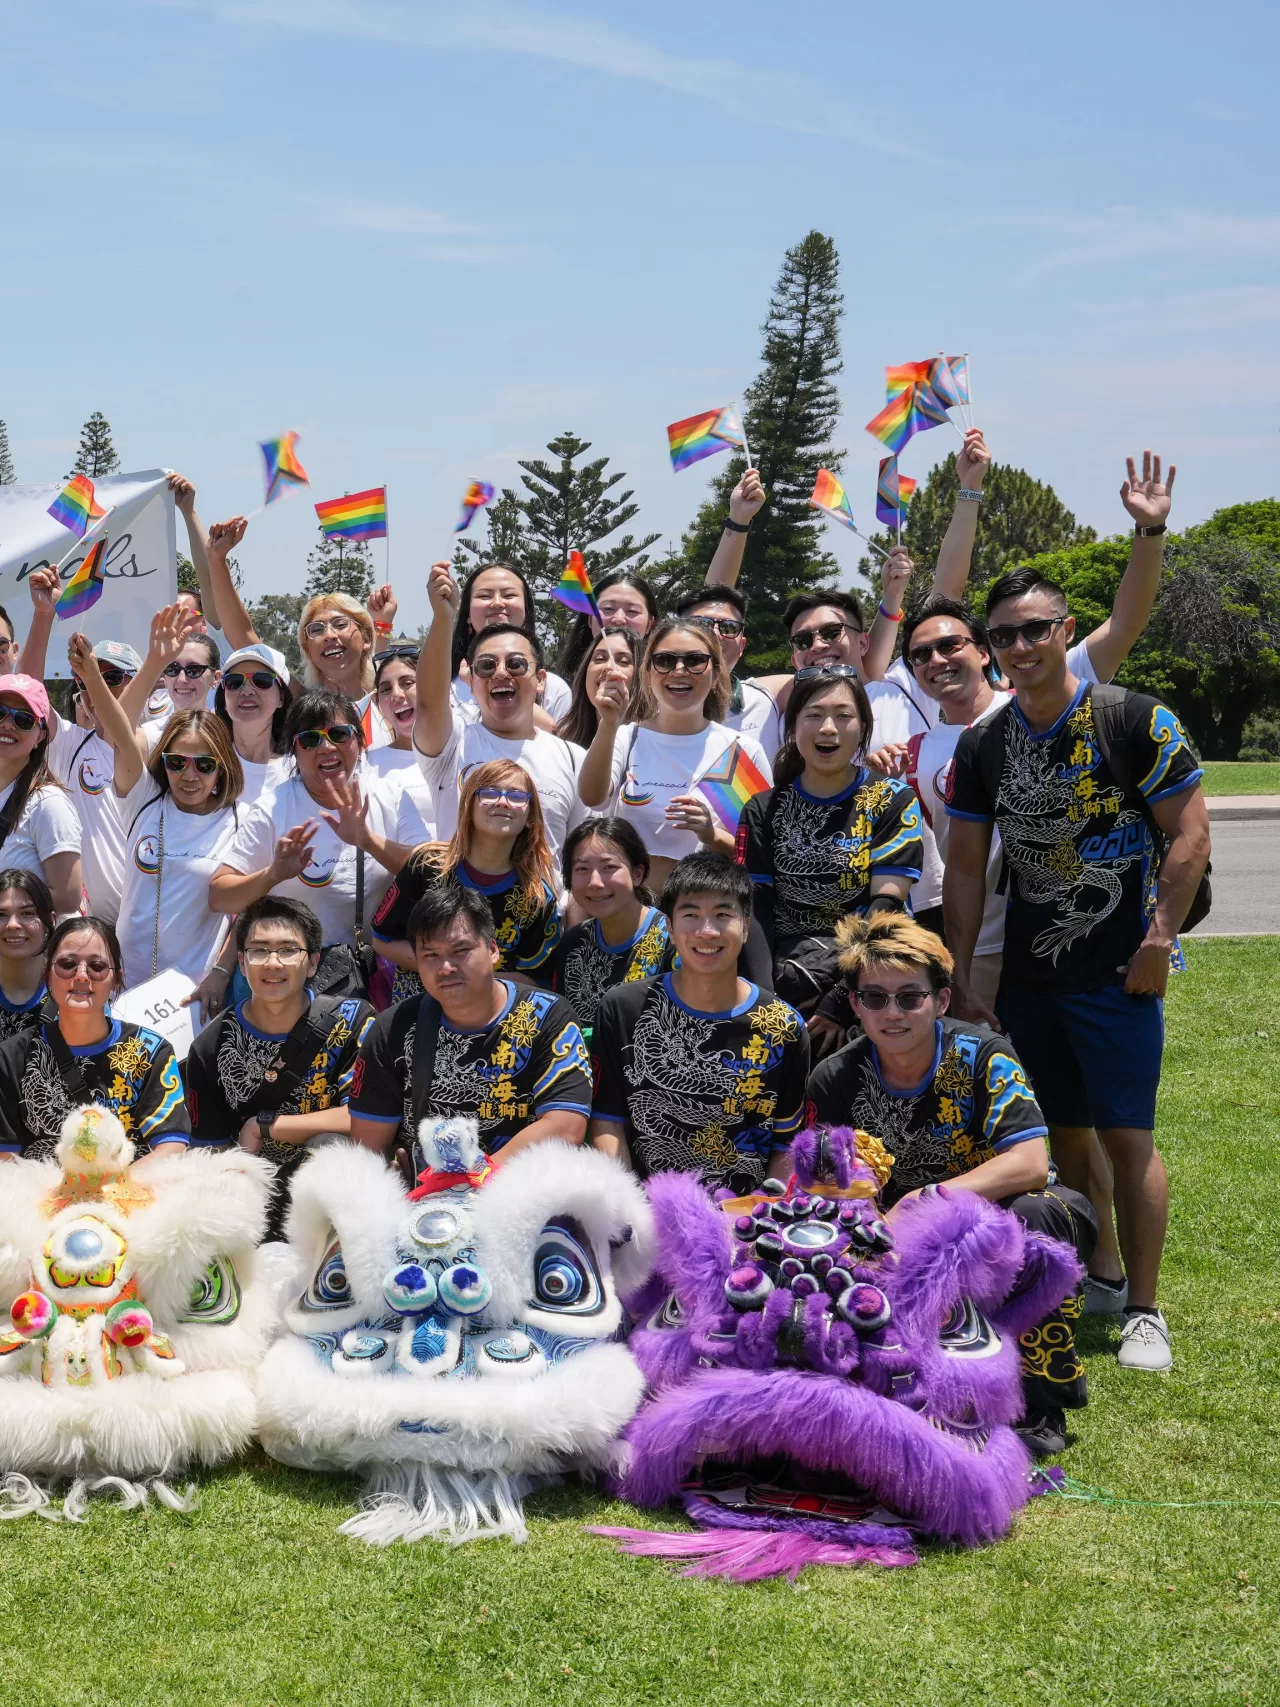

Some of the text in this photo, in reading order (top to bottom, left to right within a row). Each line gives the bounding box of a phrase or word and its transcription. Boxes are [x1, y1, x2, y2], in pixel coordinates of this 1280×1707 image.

[16, 533, 158, 584] nals
[642, 781, 689, 789] peacock
[1069, 739, 1099, 801] 南海
[848, 813, 873, 871] 南海
[144, 998, 180, 1025] 161
[489, 1040, 518, 1102] 南海
[735, 1034, 770, 1099] 南海
[936, 1096, 975, 1157] 南海
